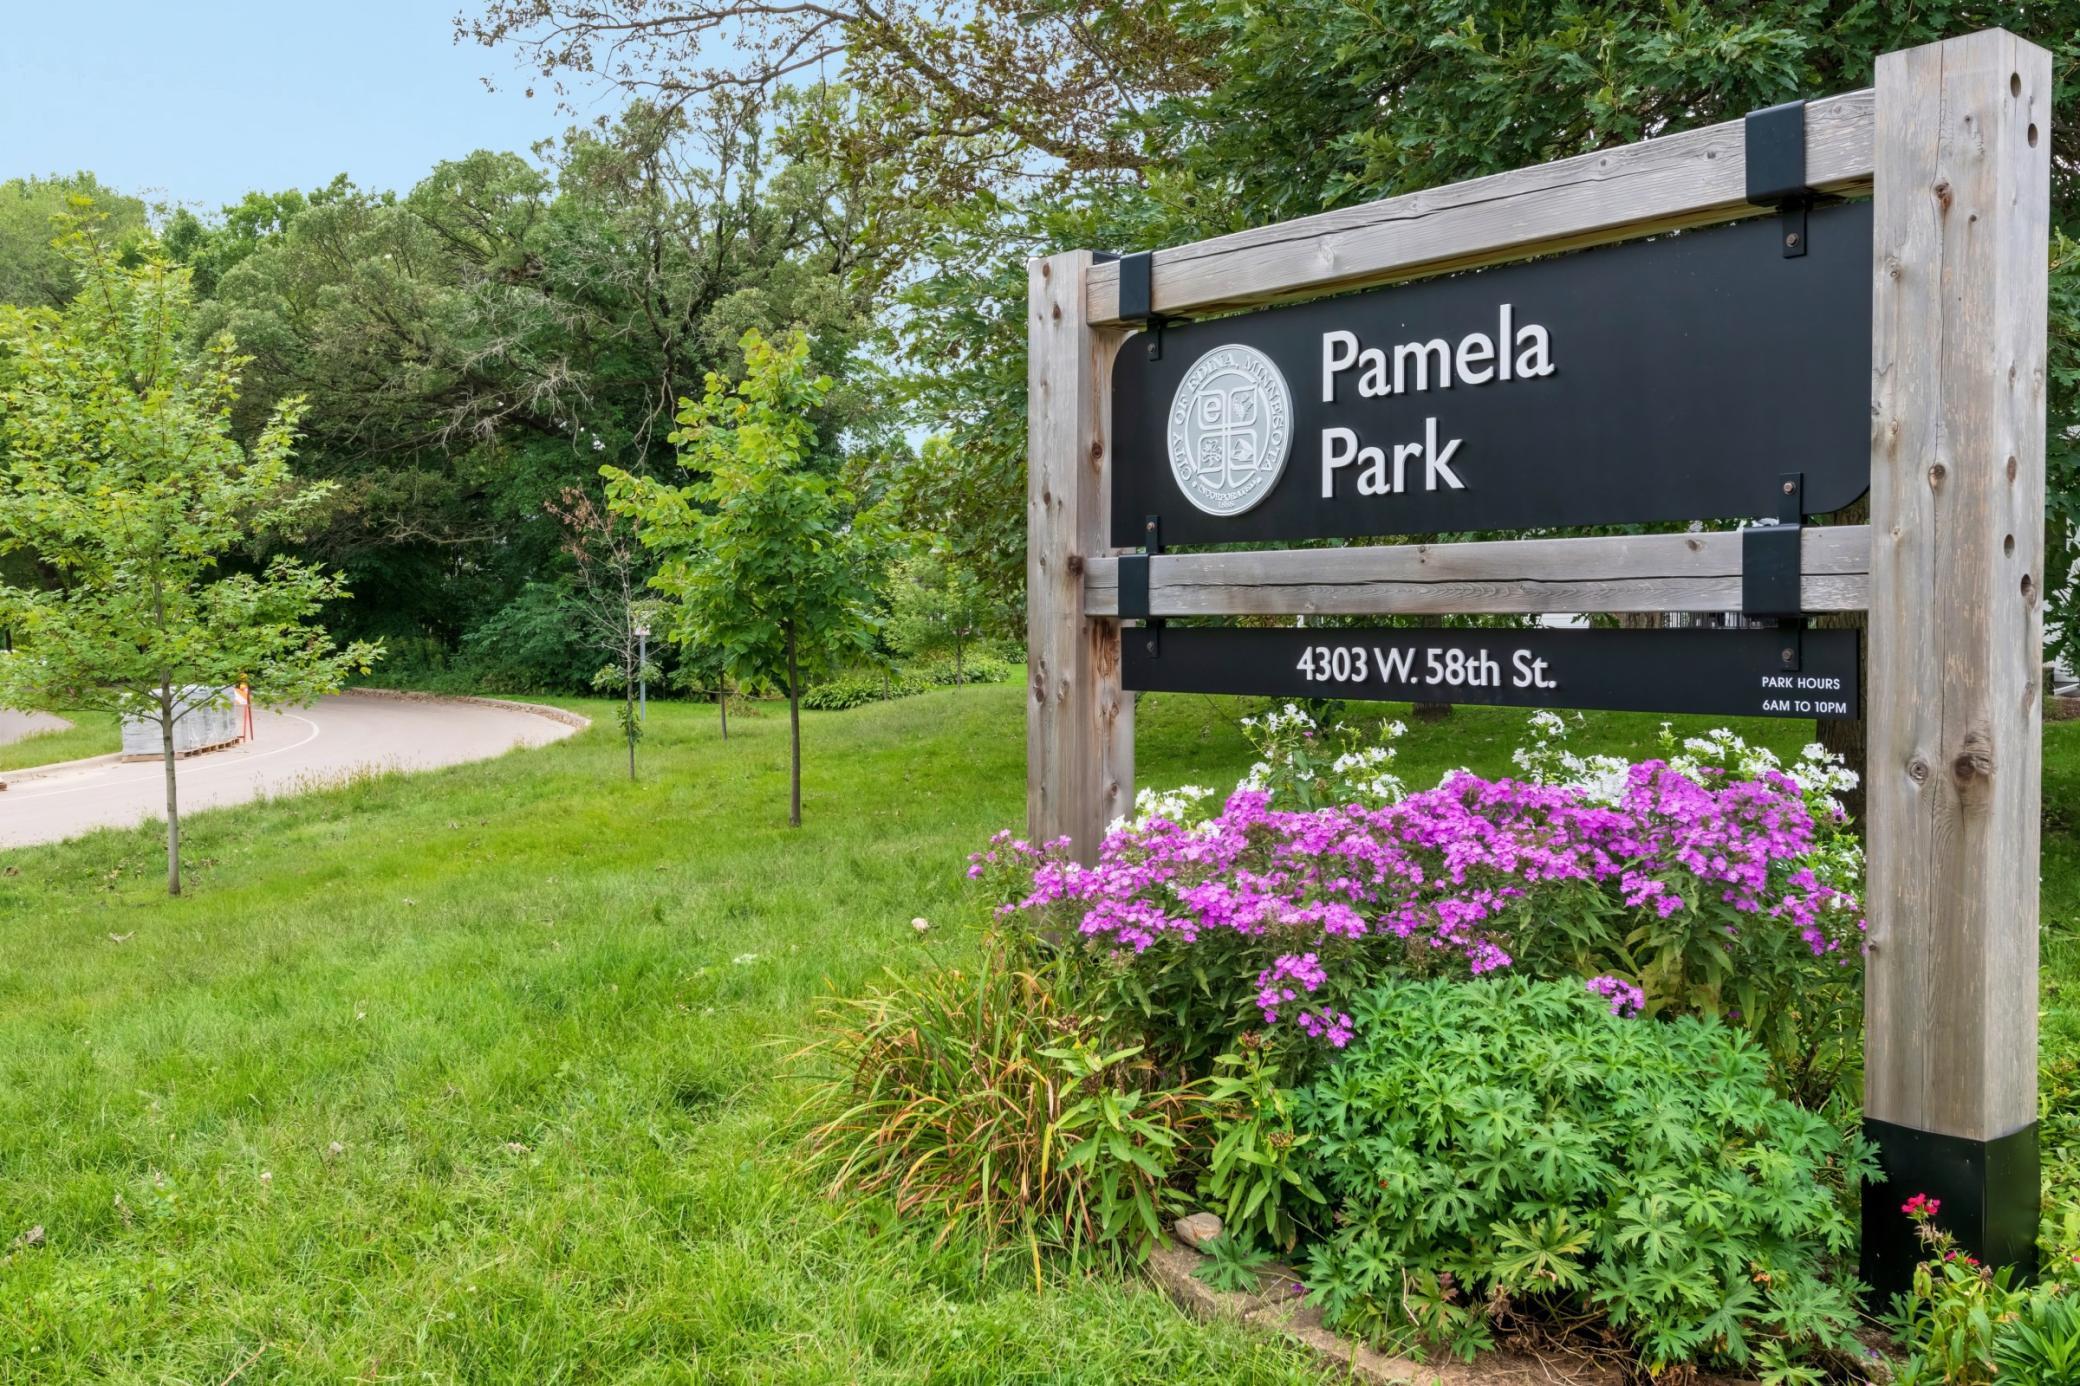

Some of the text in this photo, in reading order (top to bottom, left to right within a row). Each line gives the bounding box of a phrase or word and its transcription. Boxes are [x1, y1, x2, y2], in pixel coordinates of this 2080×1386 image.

[1322, 303, 1555, 402] Pamela
[1174, 394, 1189, 425] OF
[1244, 354, 1285, 472] MINNESOTA
[1172, 432, 1193, 482] CITY
[1321, 416, 1466, 498] Park
[1296, 645, 1557, 688] 4303 W. 58th St.
[1761, 676, 1841, 690] PARK HOURS
[1762, 699, 1847, 714] 6AM TO 10PM
